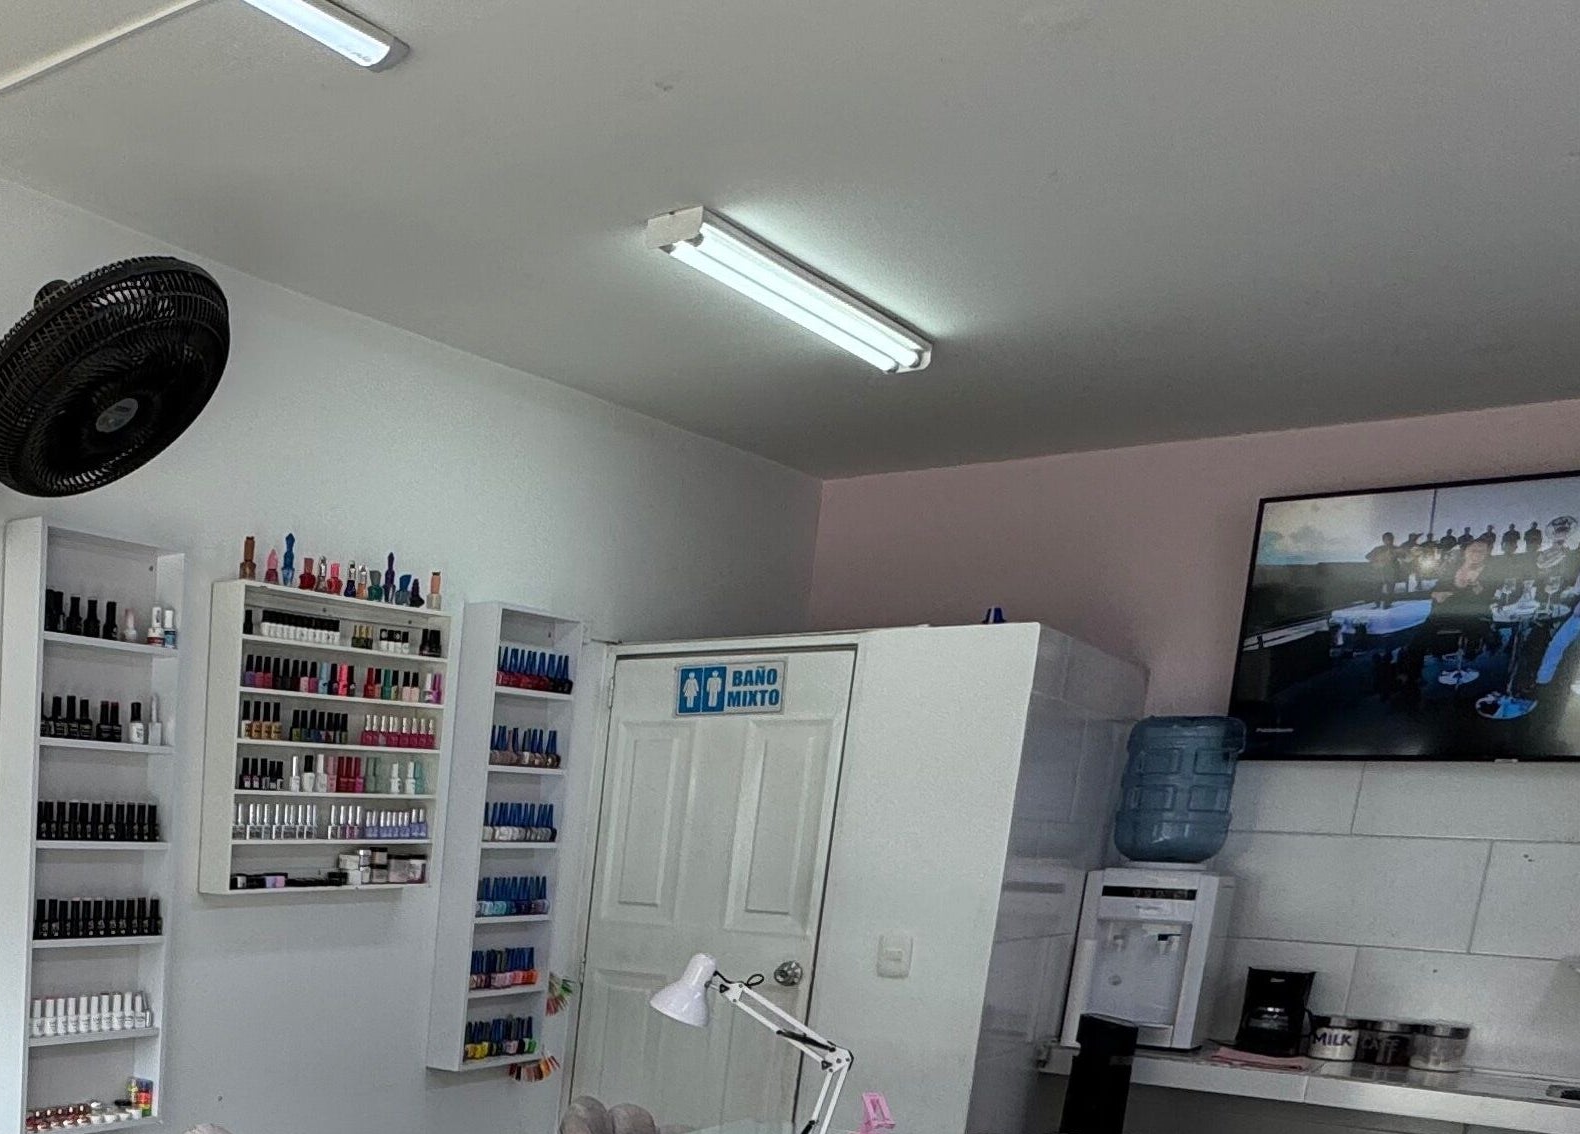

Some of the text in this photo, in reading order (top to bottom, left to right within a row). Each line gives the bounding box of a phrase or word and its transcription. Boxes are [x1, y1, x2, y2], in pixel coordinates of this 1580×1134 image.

[731, 665, 778, 687] BAÑO
[727, 688, 780, 708] MIXTO
[1313, 1032, 1353, 1047] MILK
